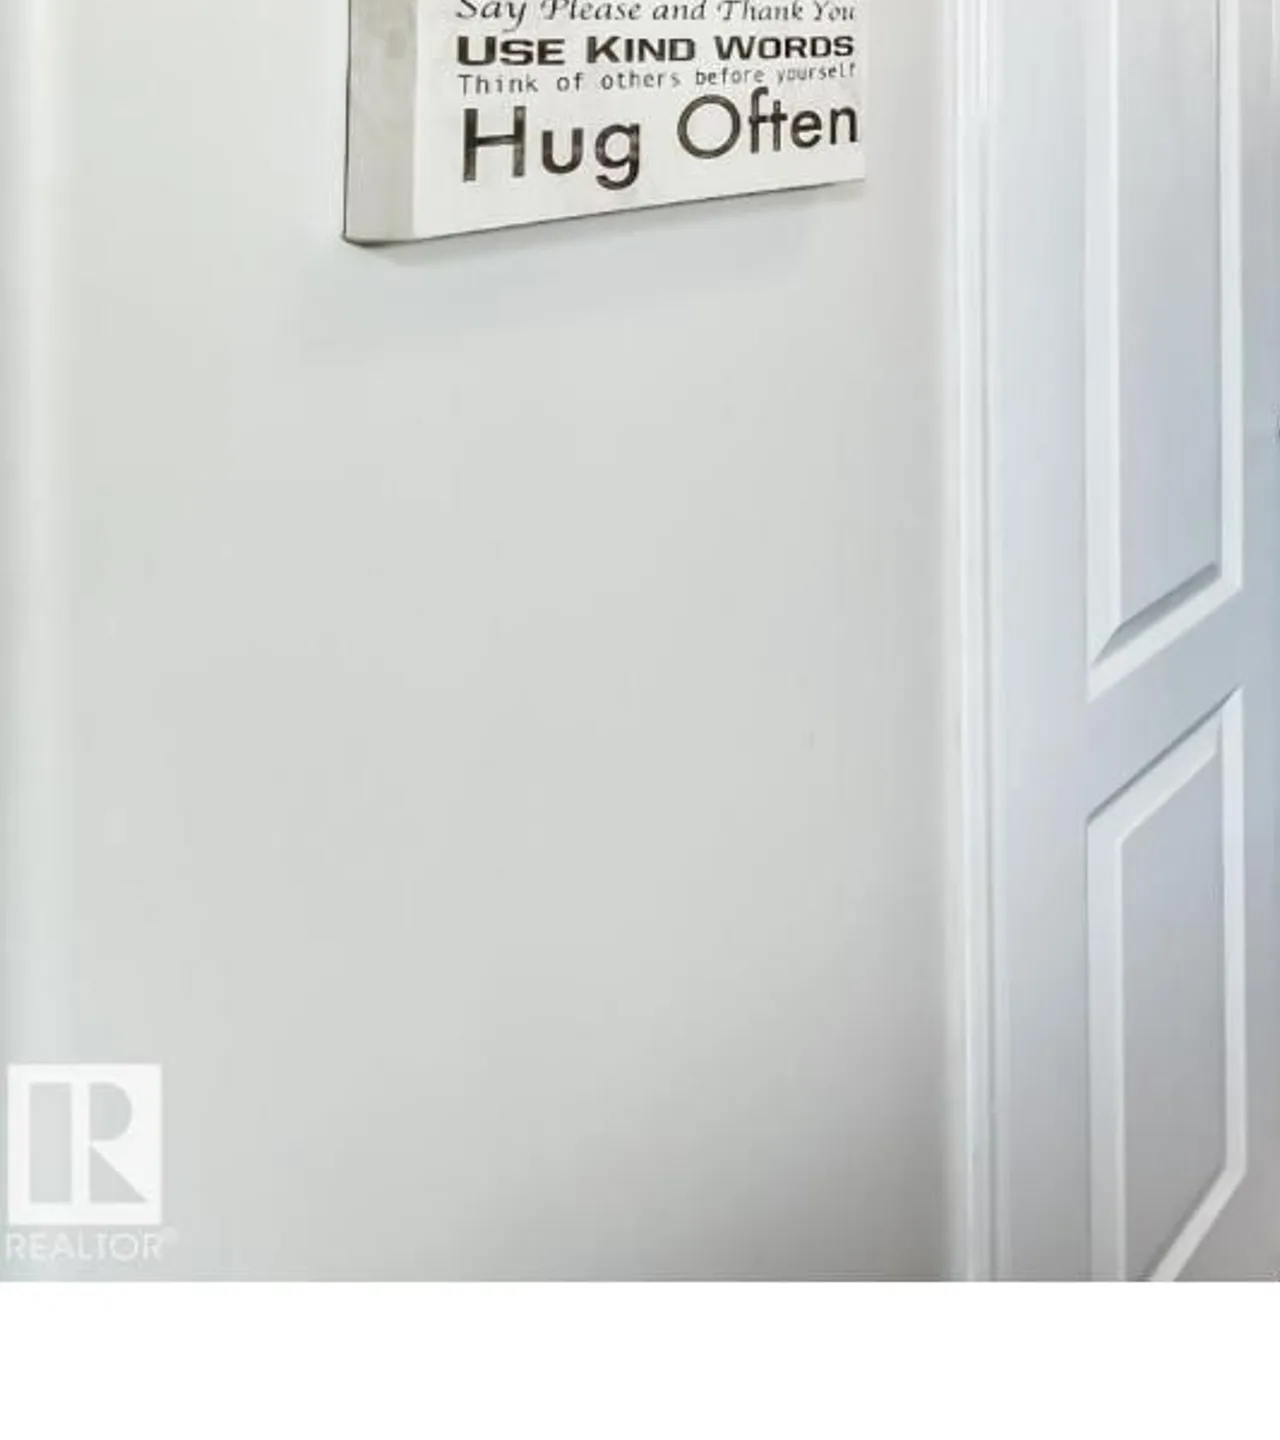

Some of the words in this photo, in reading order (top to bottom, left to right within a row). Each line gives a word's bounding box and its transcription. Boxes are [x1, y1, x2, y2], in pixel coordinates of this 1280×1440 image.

[457, 72, 540, 96] Think
[556, 70, 585, 93] of
[600, 69, 682, 92] others
[694, 67, 765, 87] before
[775, 61, 857, 86] yourself
[461, 104, 642, 192] Hug
[676, 85, 861, 161] Often
